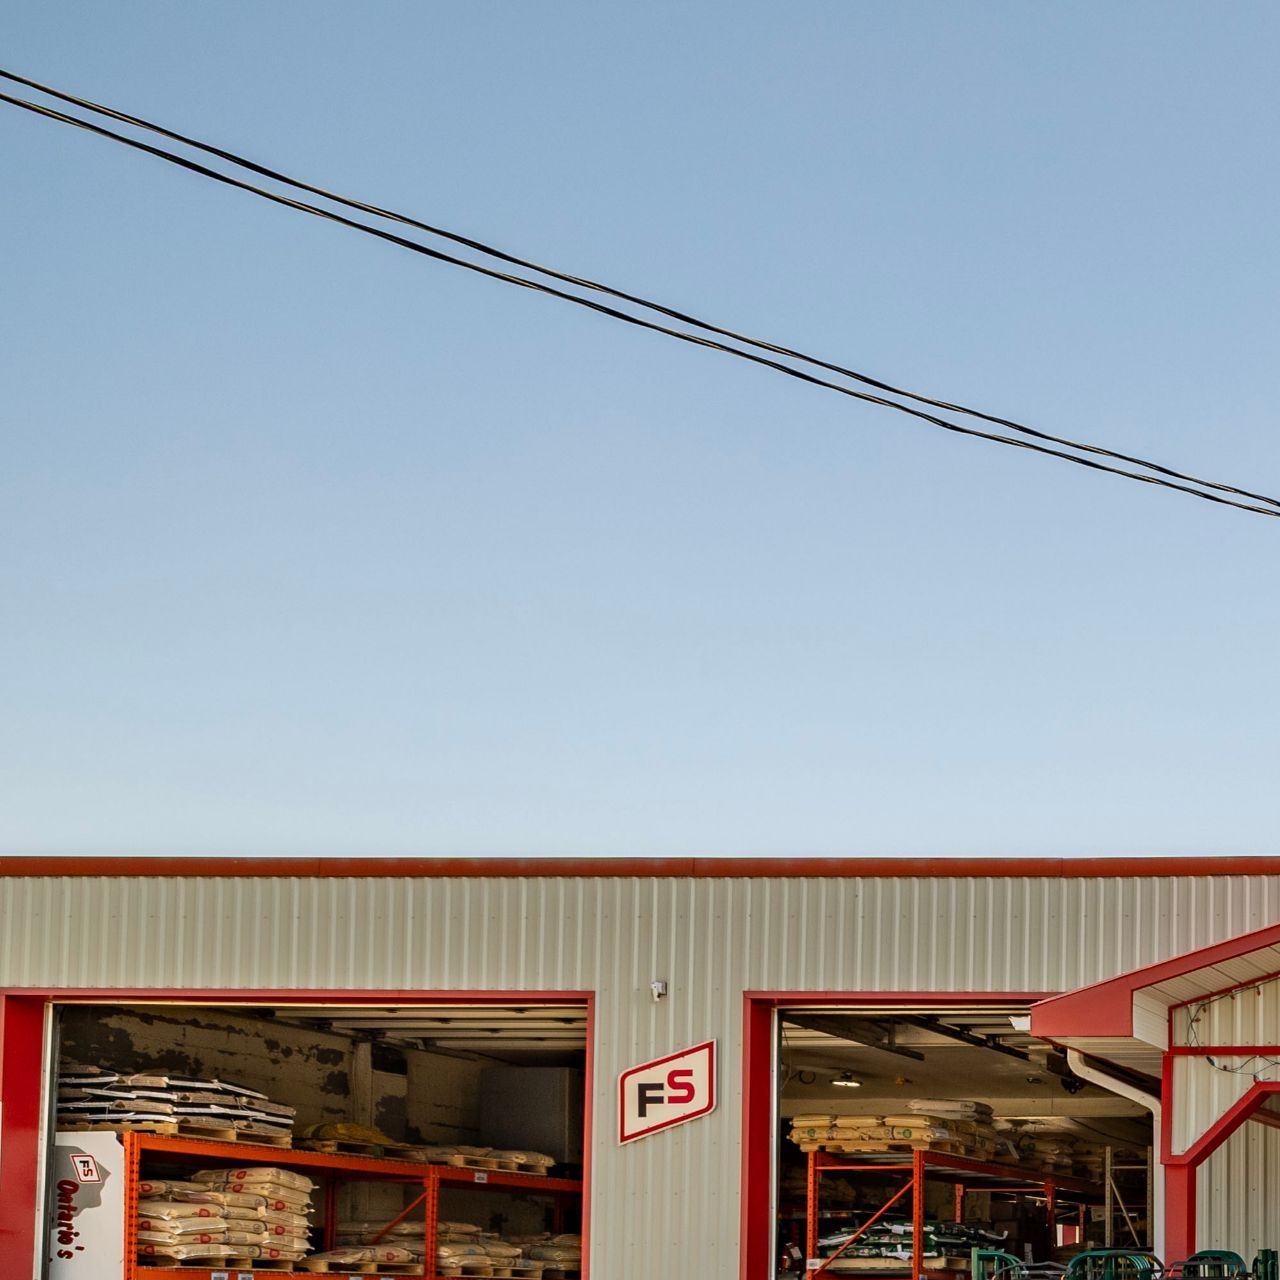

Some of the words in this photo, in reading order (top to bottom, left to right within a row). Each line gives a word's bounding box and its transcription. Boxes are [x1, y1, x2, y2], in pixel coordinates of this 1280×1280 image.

[638, 1069, 695, 1117] FS
[79, 1160, 93, 1177] FS
[57, 1180, 85, 1259] Ontario's
